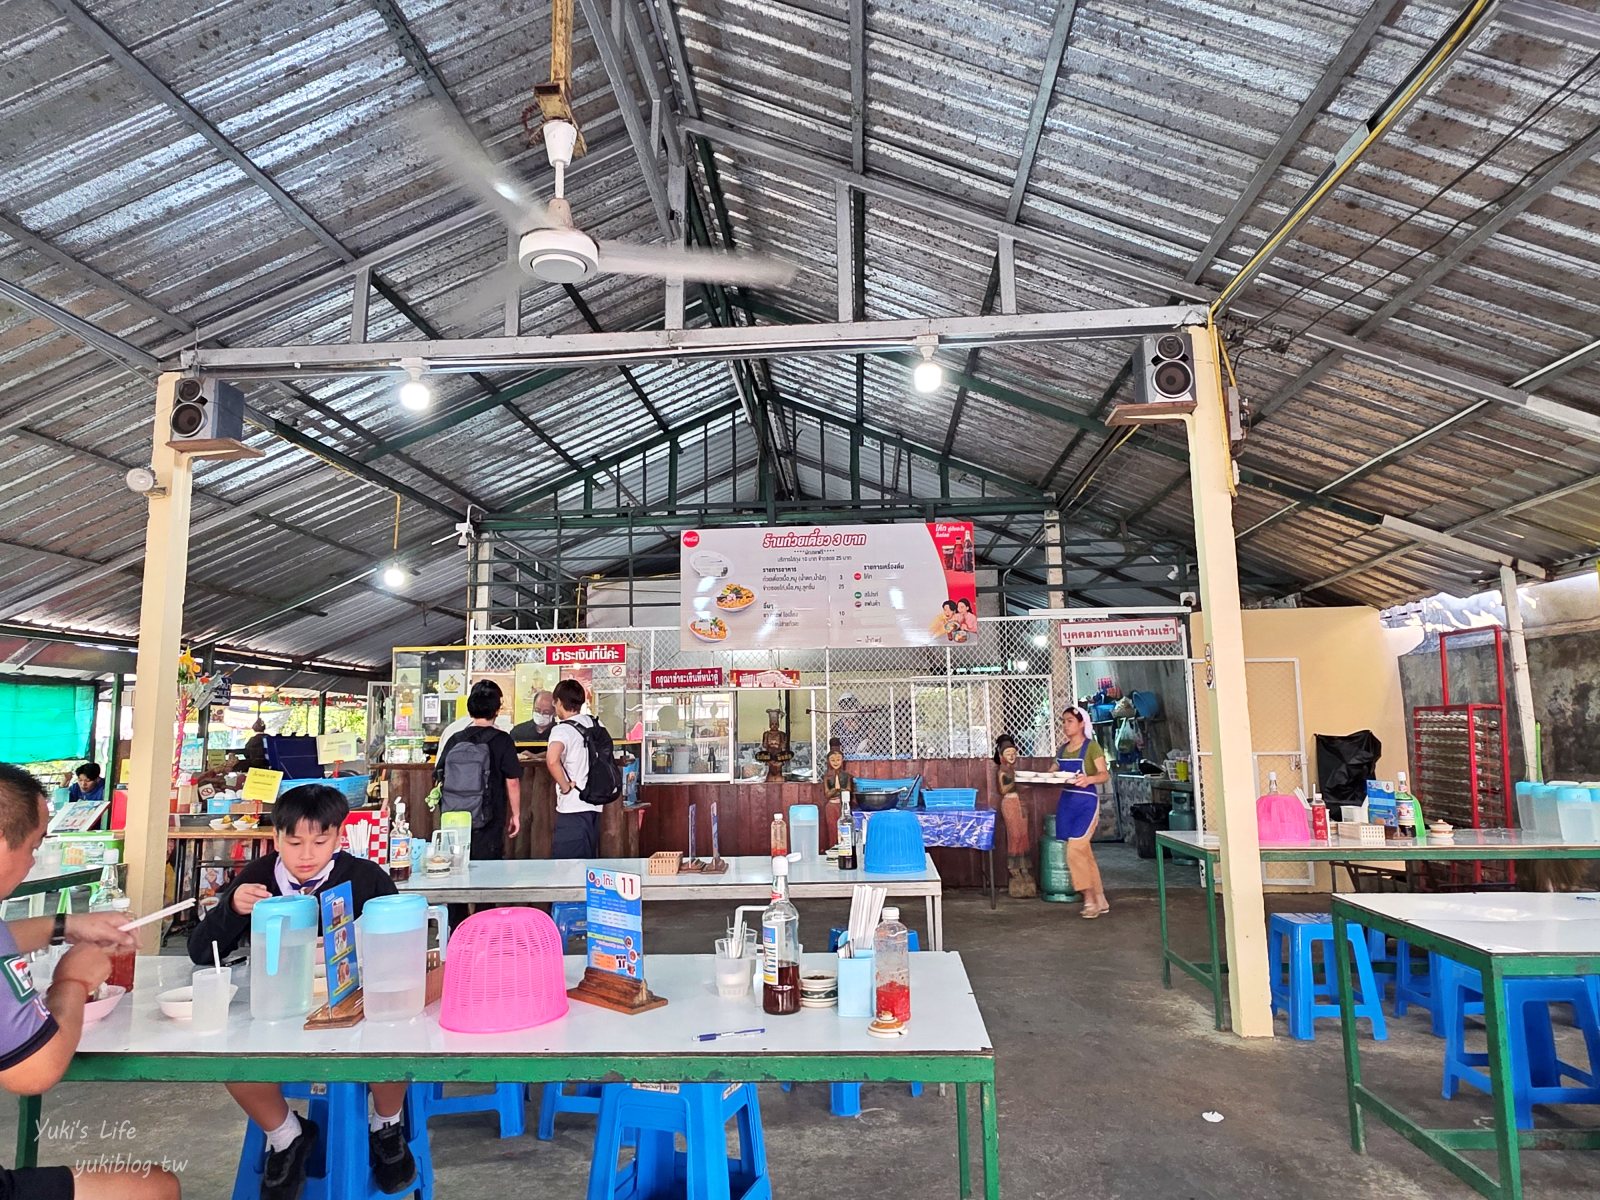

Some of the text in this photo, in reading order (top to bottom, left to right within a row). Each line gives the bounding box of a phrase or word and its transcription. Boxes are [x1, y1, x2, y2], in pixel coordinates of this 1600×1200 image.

[763, 528, 866, 548] ร้านก๋วยเตี๋ยว 3 บาท
[1063, 624, 1175, 643] บุคคลภายนอกห้ามเข้า
[552, 646, 620, 660] ชำระเงินที่นี่ค่ะ
[655, 669, 719, 686] กรุณาชำระเงินที่หน้าตู้
[621, 877, 633, 895] 11
